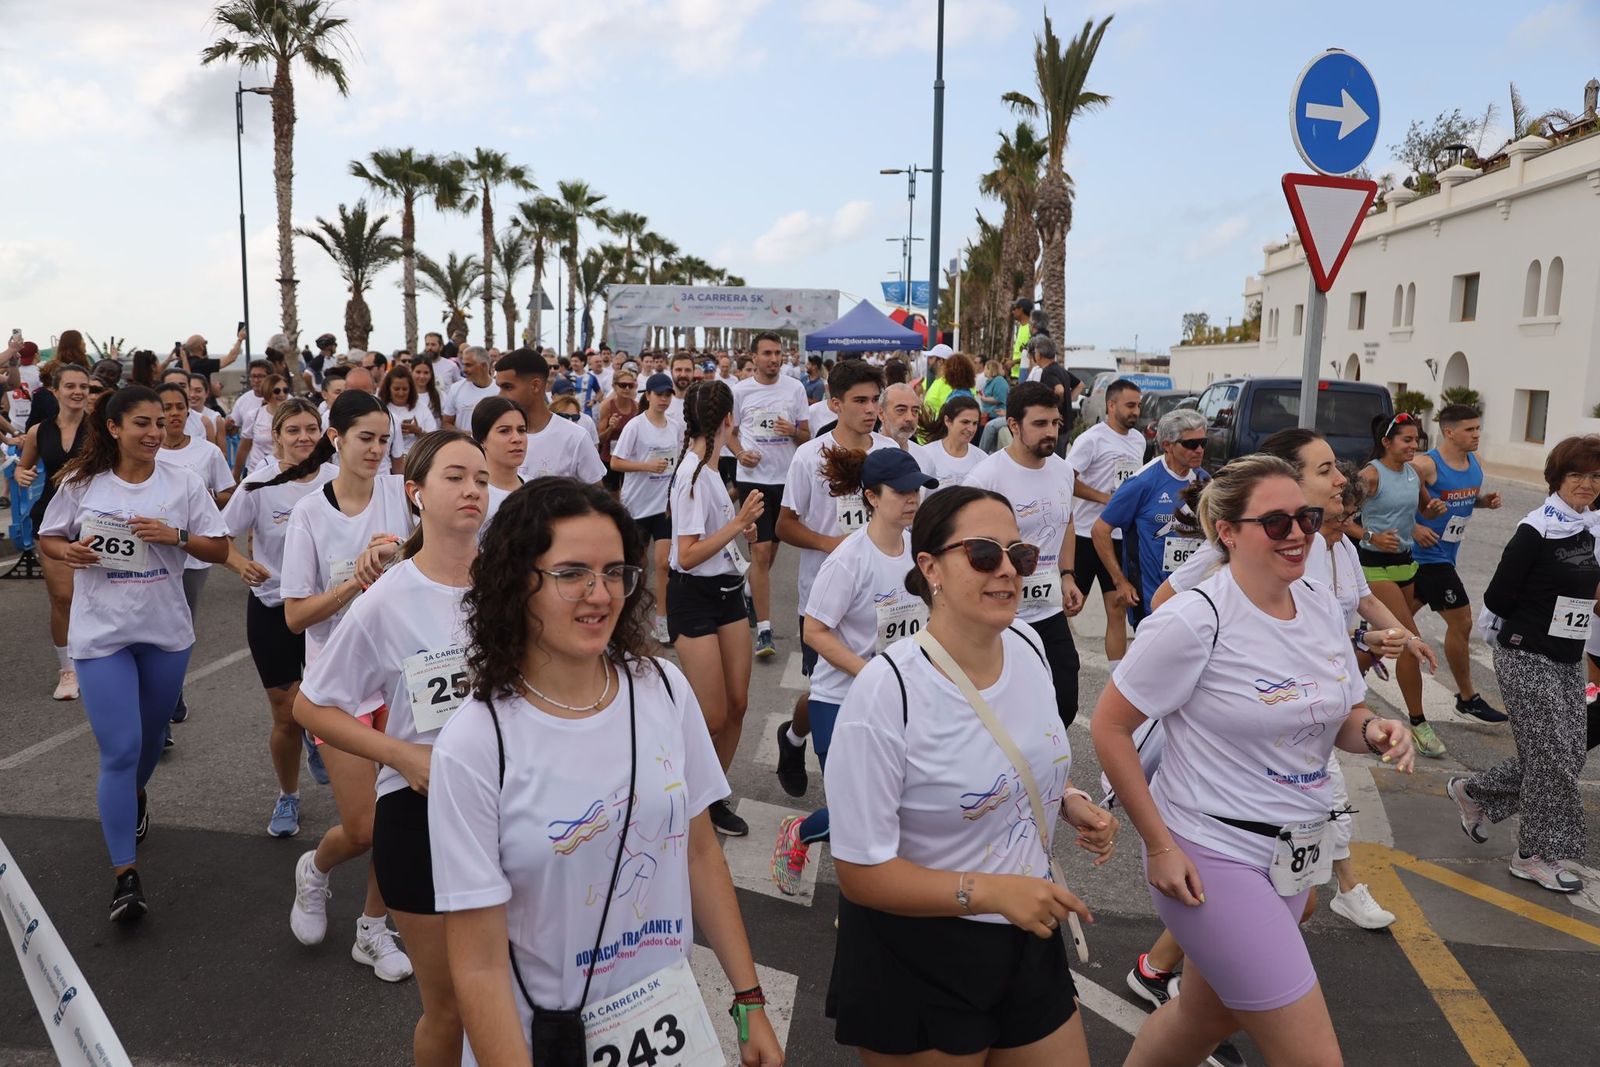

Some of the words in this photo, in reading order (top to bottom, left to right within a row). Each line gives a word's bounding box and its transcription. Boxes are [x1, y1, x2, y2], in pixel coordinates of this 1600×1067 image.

[682, 292, 695, 301] 3A
[697, 294, 747, 303] CARRERA
[751, 295, 764, 303] 5K
[90, 535, 135, 556] 263
[1022, 584, 1052, 598] 167
[886, 619, 920, 638] 910
[436, 647, 465, 658] CARRER
[582, 1012, 596, 1022] 3A
[598, 988, 647, 1016] CARRERA
[648, 979, 661, 992] 5K
[611, 1001, 642, 1019] TRASPLANTE
[593, 1014, 685, 1067] 243
